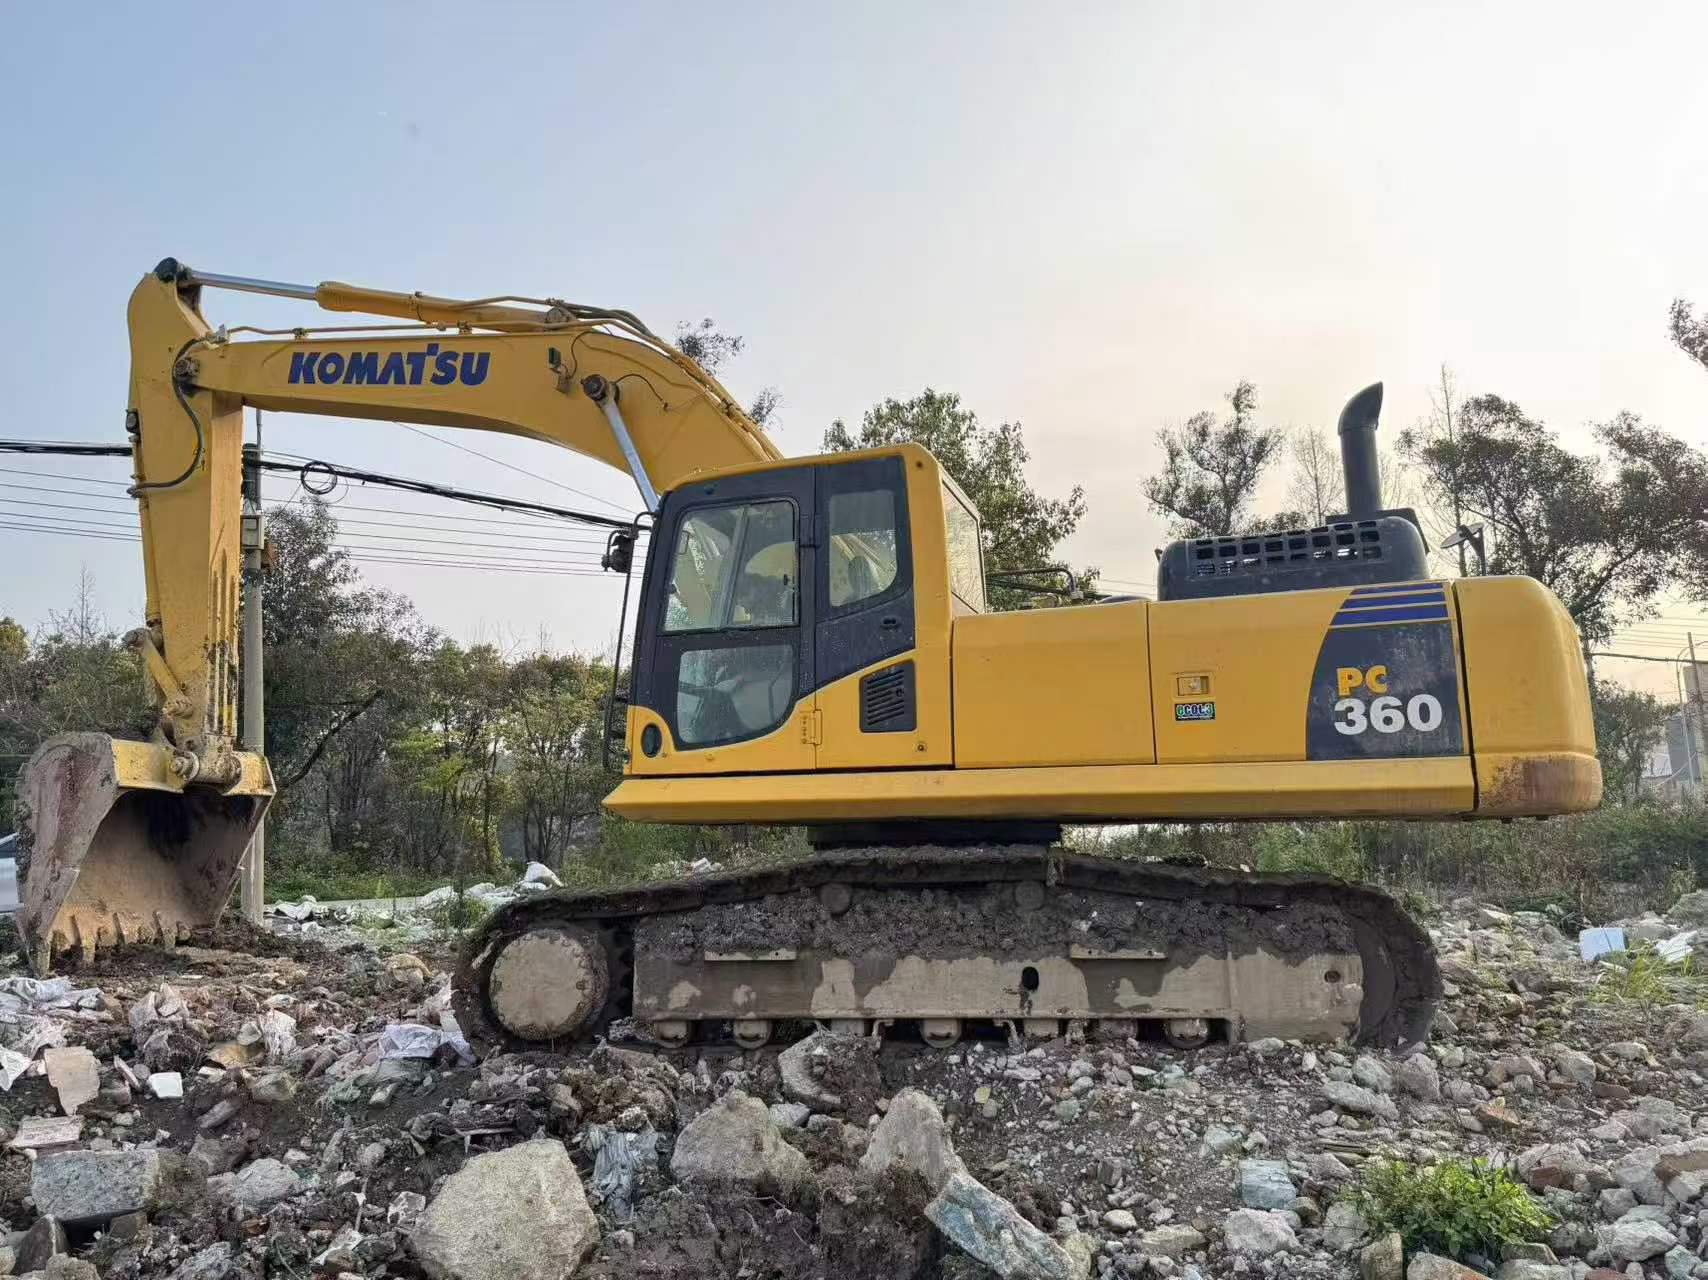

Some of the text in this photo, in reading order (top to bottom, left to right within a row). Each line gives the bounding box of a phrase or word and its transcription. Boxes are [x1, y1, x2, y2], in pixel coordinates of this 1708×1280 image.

[288, 343, 491, 386] KOMATSU
[1336, 665, 1388, 696] PC
[1334, 694, 1442, 735] 360
